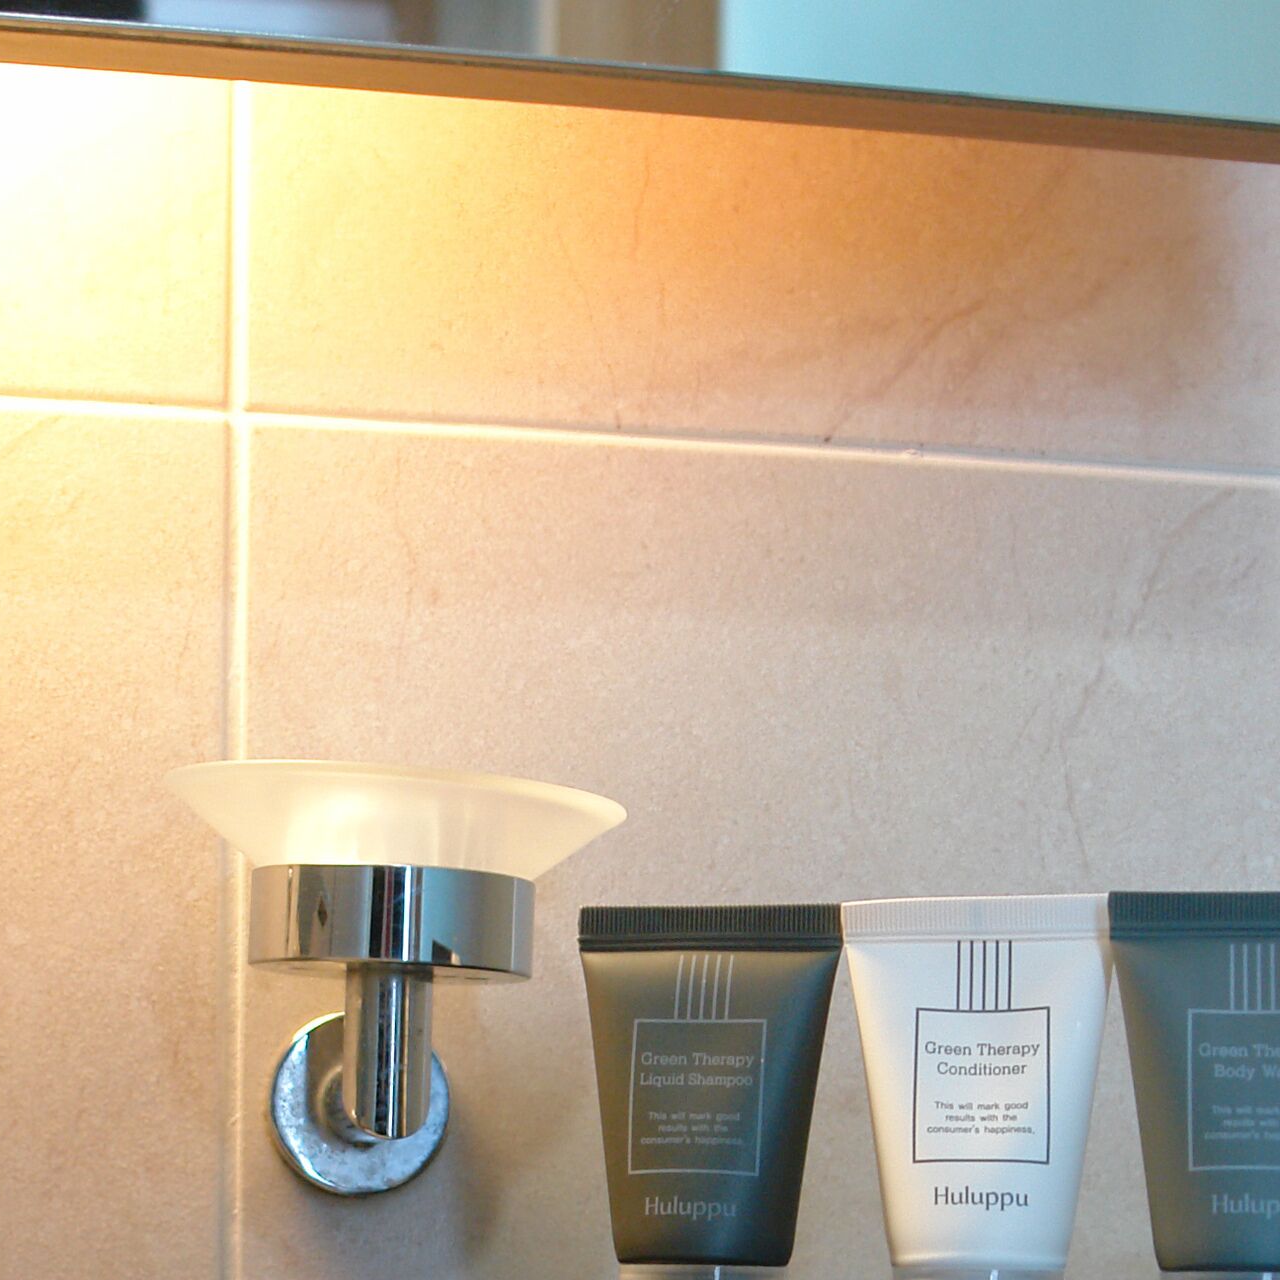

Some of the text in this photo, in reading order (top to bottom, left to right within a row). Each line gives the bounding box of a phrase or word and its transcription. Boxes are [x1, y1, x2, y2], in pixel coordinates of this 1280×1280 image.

[925, 1041, 1040, 1057] Green Therapy
[1199, 1043, 1248, 1057] Green
[641, 1052, 754, 1068] Green Therapy
[937, 1062, 1027, 1076] Conditioner
[1214, 1065, 1255, 1080] Body
[640, 1073, 752, 1088] Liquid Shampoo
[934, 1101, 1028, 1111] This will mark good
[945, 1113, 1017, 1122] results with the
[934, 1186, 1029, 1210] Huluppu
[645, 1197, 737, 1221] Huluppu
